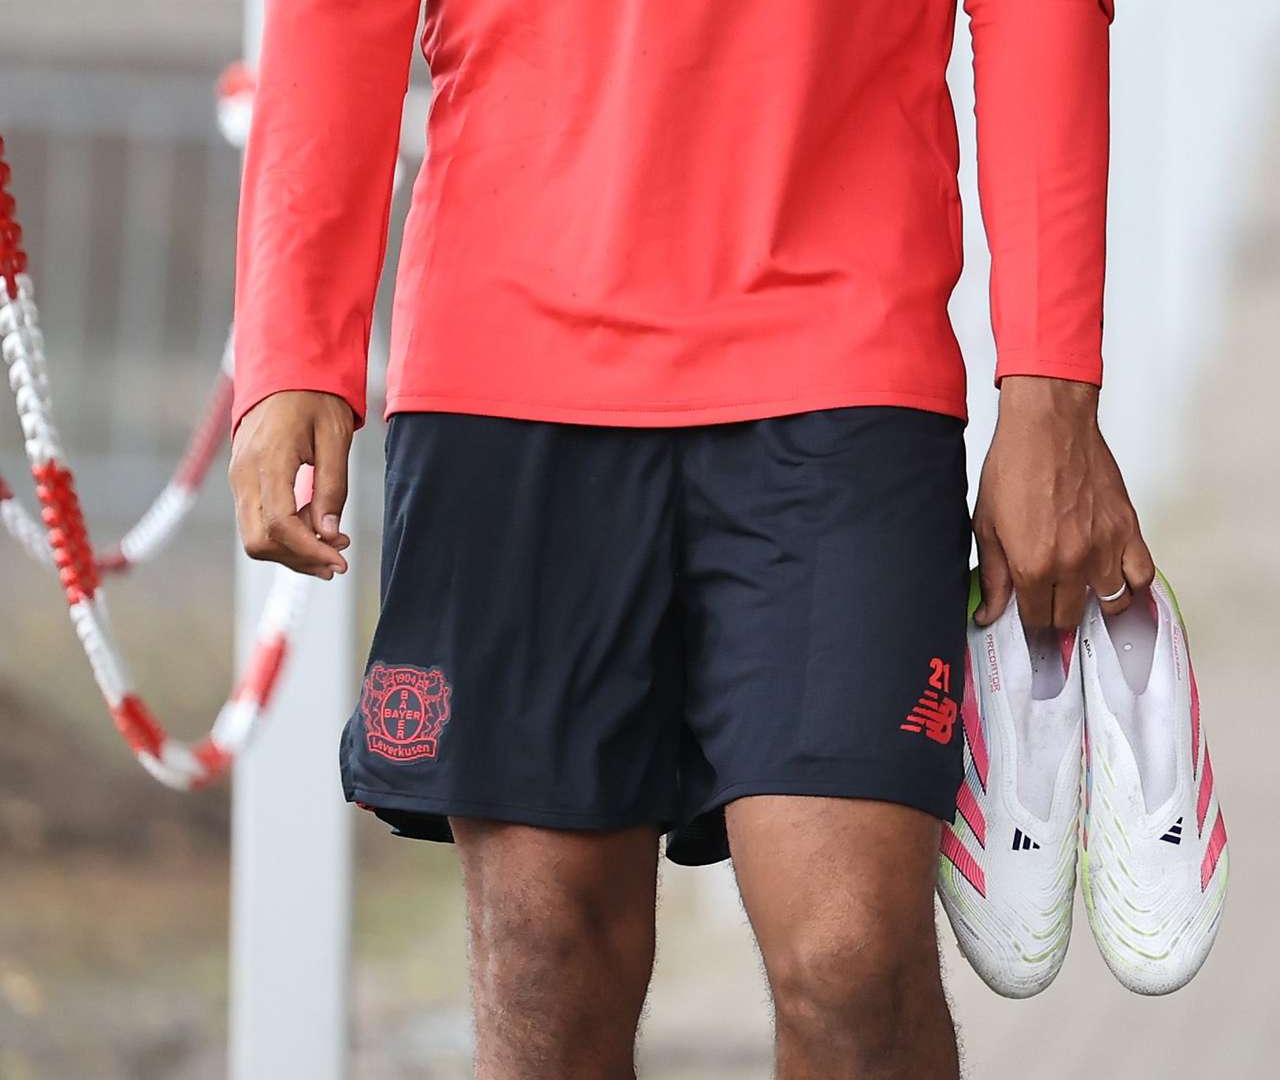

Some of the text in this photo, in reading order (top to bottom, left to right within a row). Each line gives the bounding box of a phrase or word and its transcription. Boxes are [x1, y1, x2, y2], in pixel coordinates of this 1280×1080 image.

[929, 657, 950, 693] 21
[384, 708, 421, 720] BAYER
[371, 737, 430, 757] Leverkusen
